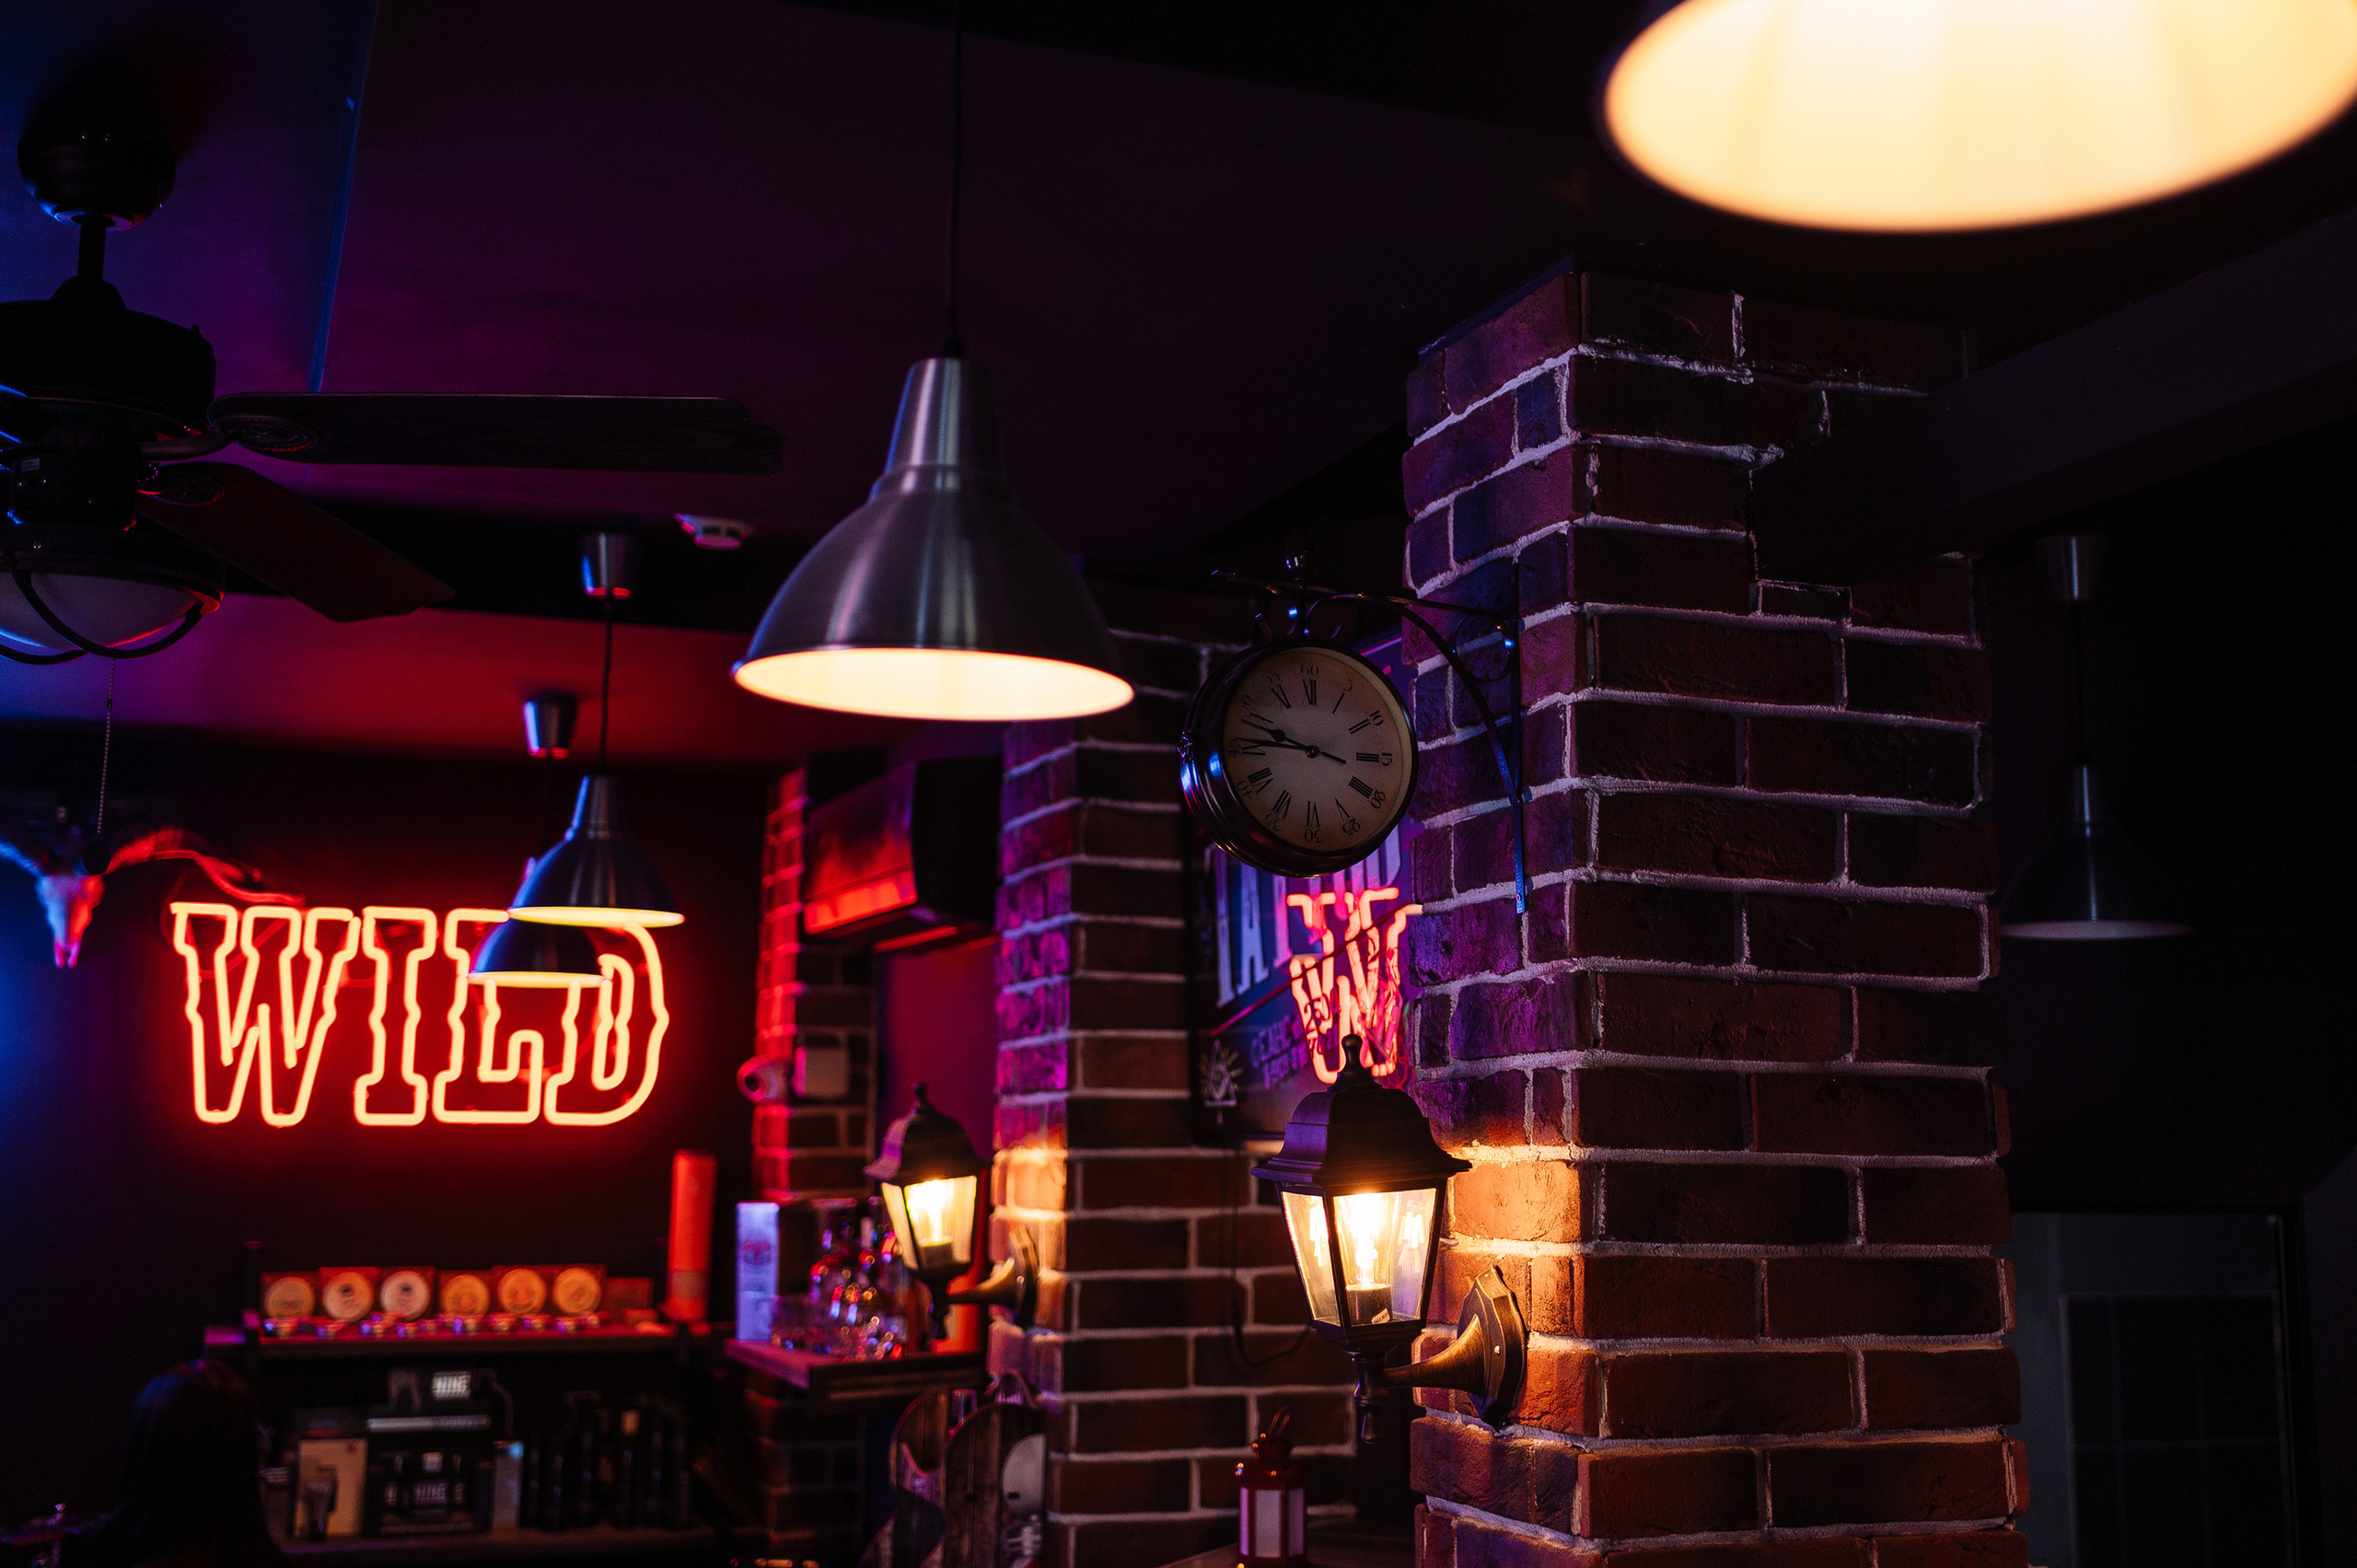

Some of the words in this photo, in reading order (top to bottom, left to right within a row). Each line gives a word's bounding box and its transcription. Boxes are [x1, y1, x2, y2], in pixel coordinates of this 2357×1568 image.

[1301, 665, 1318, 676] 60
[1303, 679, 1317, 705] XII
[1333, 693, 1344, 714] I
[1349, 719, 1370, 734] II
[1370, 711, 1384, 726] 10
[1356, 752, 1379, 762] III
[1381, 753, 1393, 766] 15
[1237, 781, 1253, 799] 40
[1370, 789, 1386, 809] 20
[1272, 790, 1292, 819] VII
[1266, 813, 1279, 831] 35
[1307, 801, 1319, 827] VI
[1305, 829, 1324, 843] 30
[1342, 819, 1361, 836] 25
[169, 902, 669, 1126] WILD
